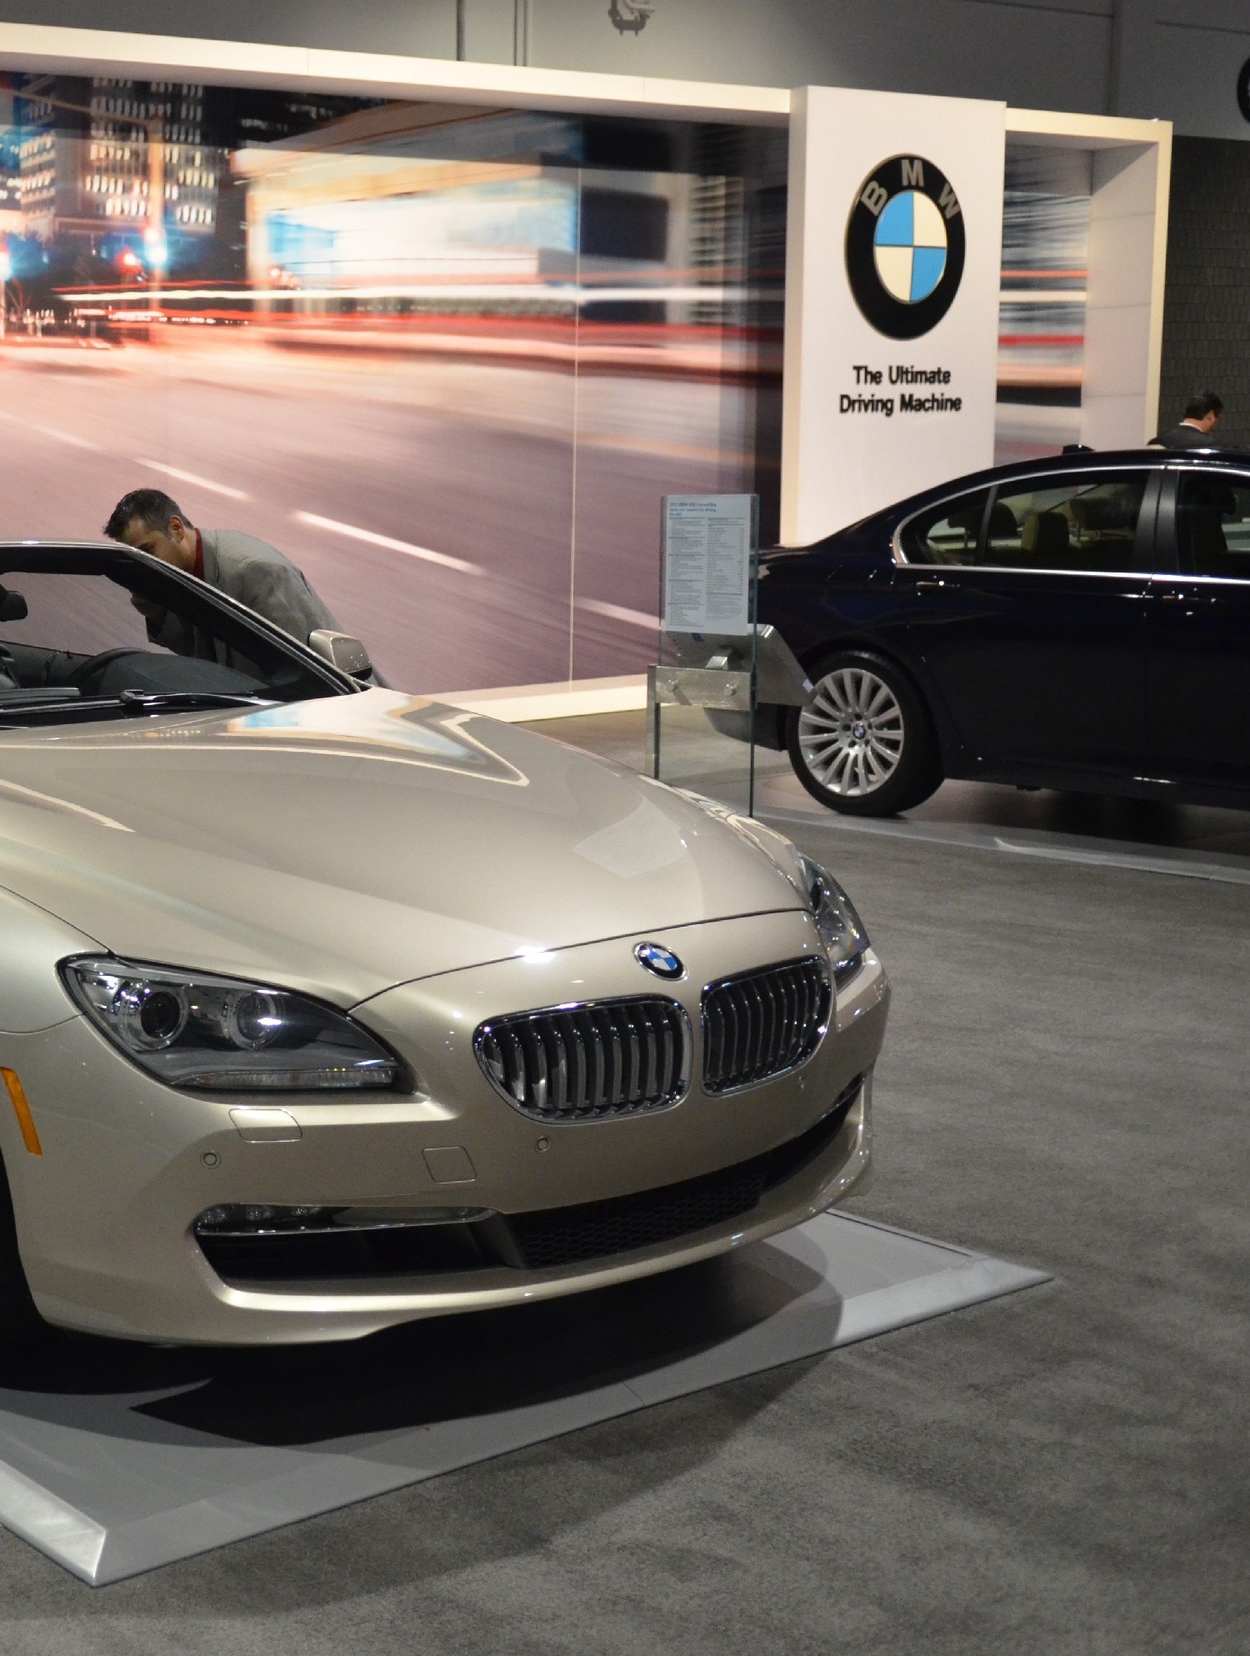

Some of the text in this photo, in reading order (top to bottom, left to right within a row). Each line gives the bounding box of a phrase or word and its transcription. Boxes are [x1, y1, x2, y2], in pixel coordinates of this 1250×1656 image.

[860, 158, 962, 220] BMW
[852, 365, 952, 386] The Ultimate
[839, 393, 963, 417] Driving Machine
